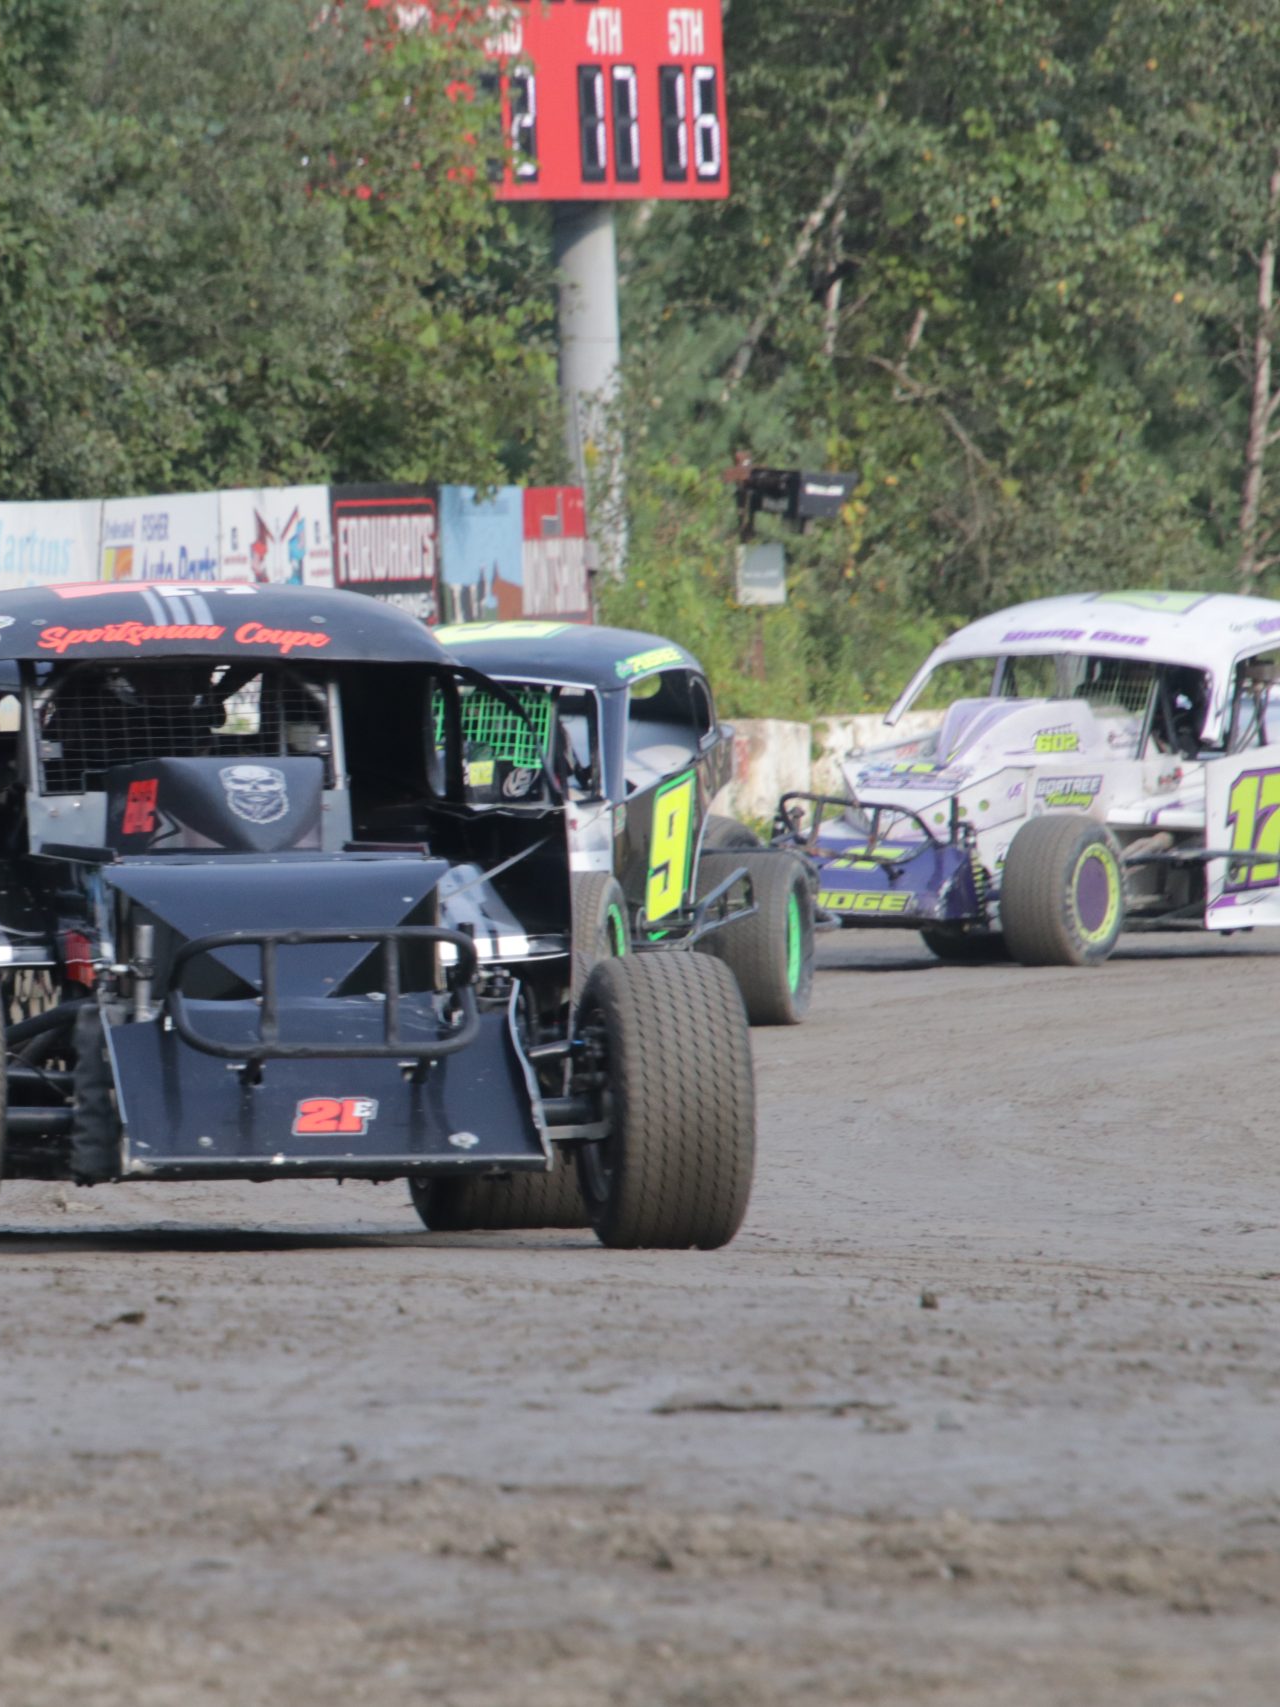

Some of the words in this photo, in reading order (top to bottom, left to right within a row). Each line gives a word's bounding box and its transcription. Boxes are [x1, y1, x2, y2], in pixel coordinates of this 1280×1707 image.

[586, 8, 623, 54] 4TH
[668, 8, 704, 54] 5TH
[594, 65, 640, 169] 17
[676, 65, 720, 176] 16
[37, 621, 225, 653] Sportsman
[235, 621, 330, 654] Coupe
[646, 775, 697, 923] 9
